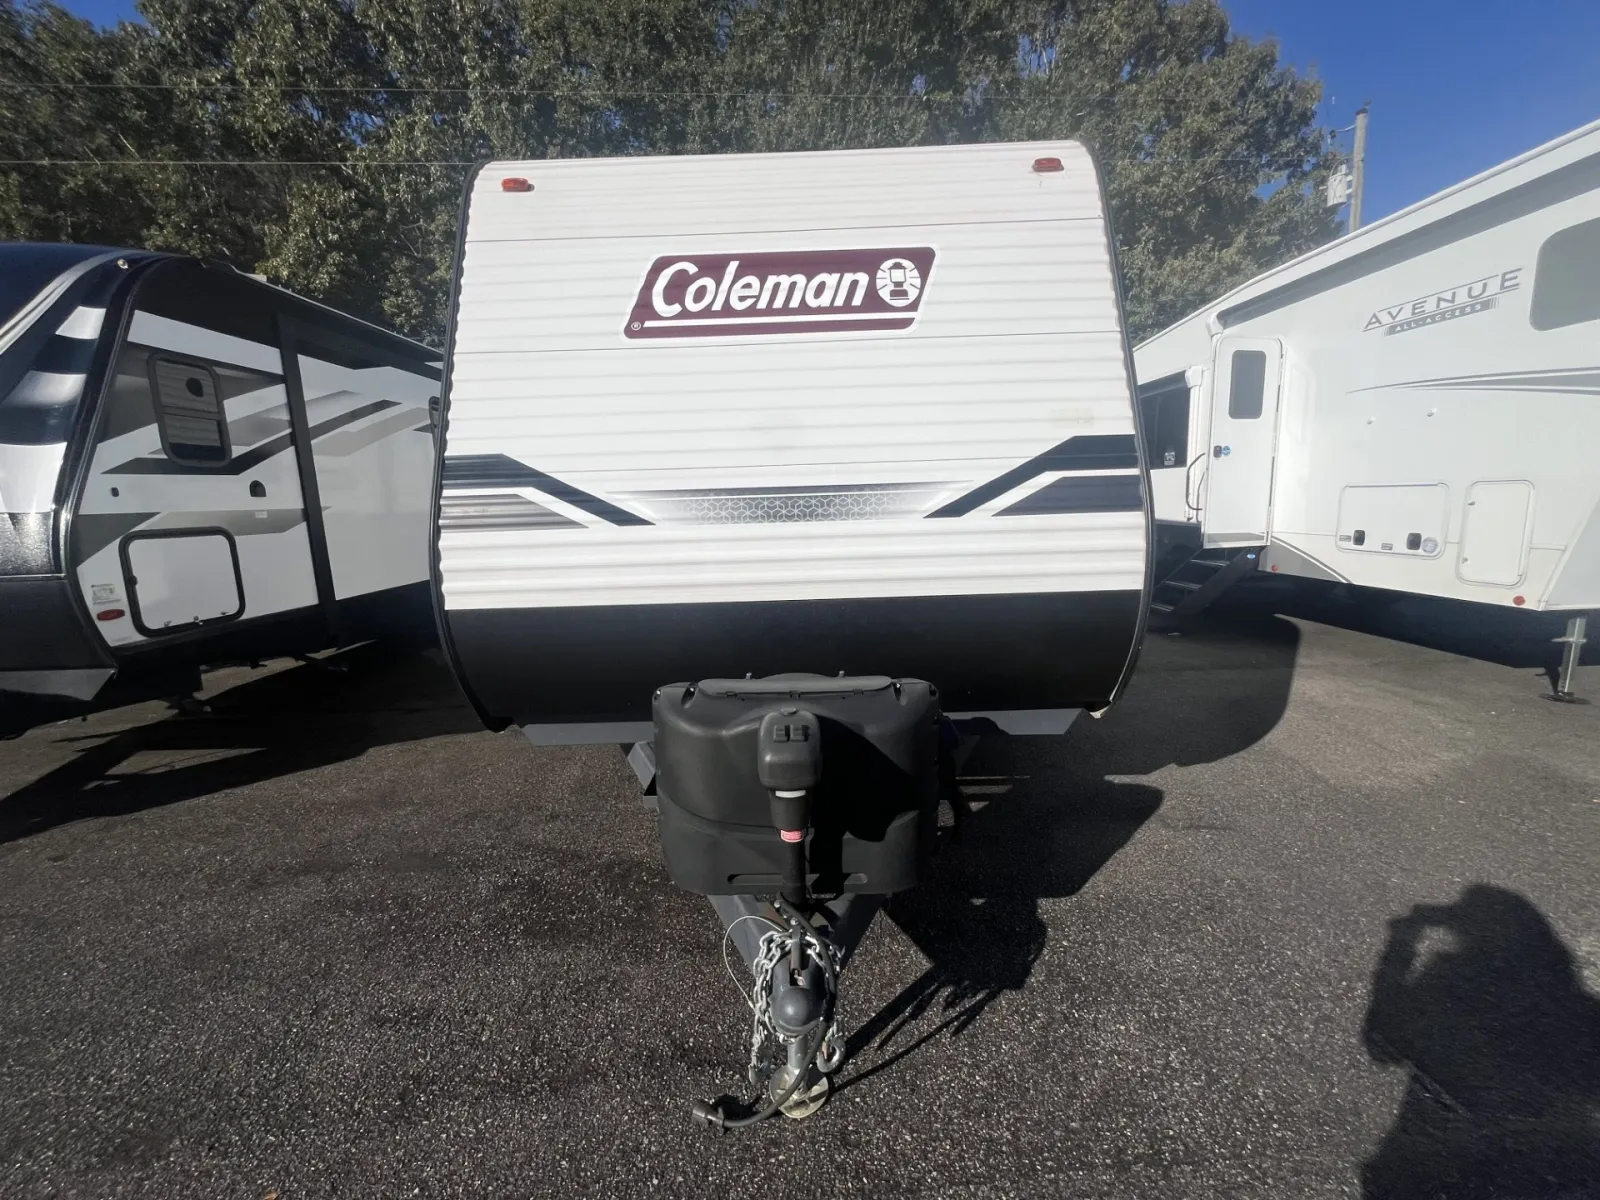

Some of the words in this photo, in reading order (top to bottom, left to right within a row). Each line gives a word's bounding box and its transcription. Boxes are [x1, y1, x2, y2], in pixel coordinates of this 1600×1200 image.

[652, 260, 870, 318] Coleman
[1364, 268, 1523, 329] AVENUE
[1395, 303, 1482, 332] ALL-ACCESS
